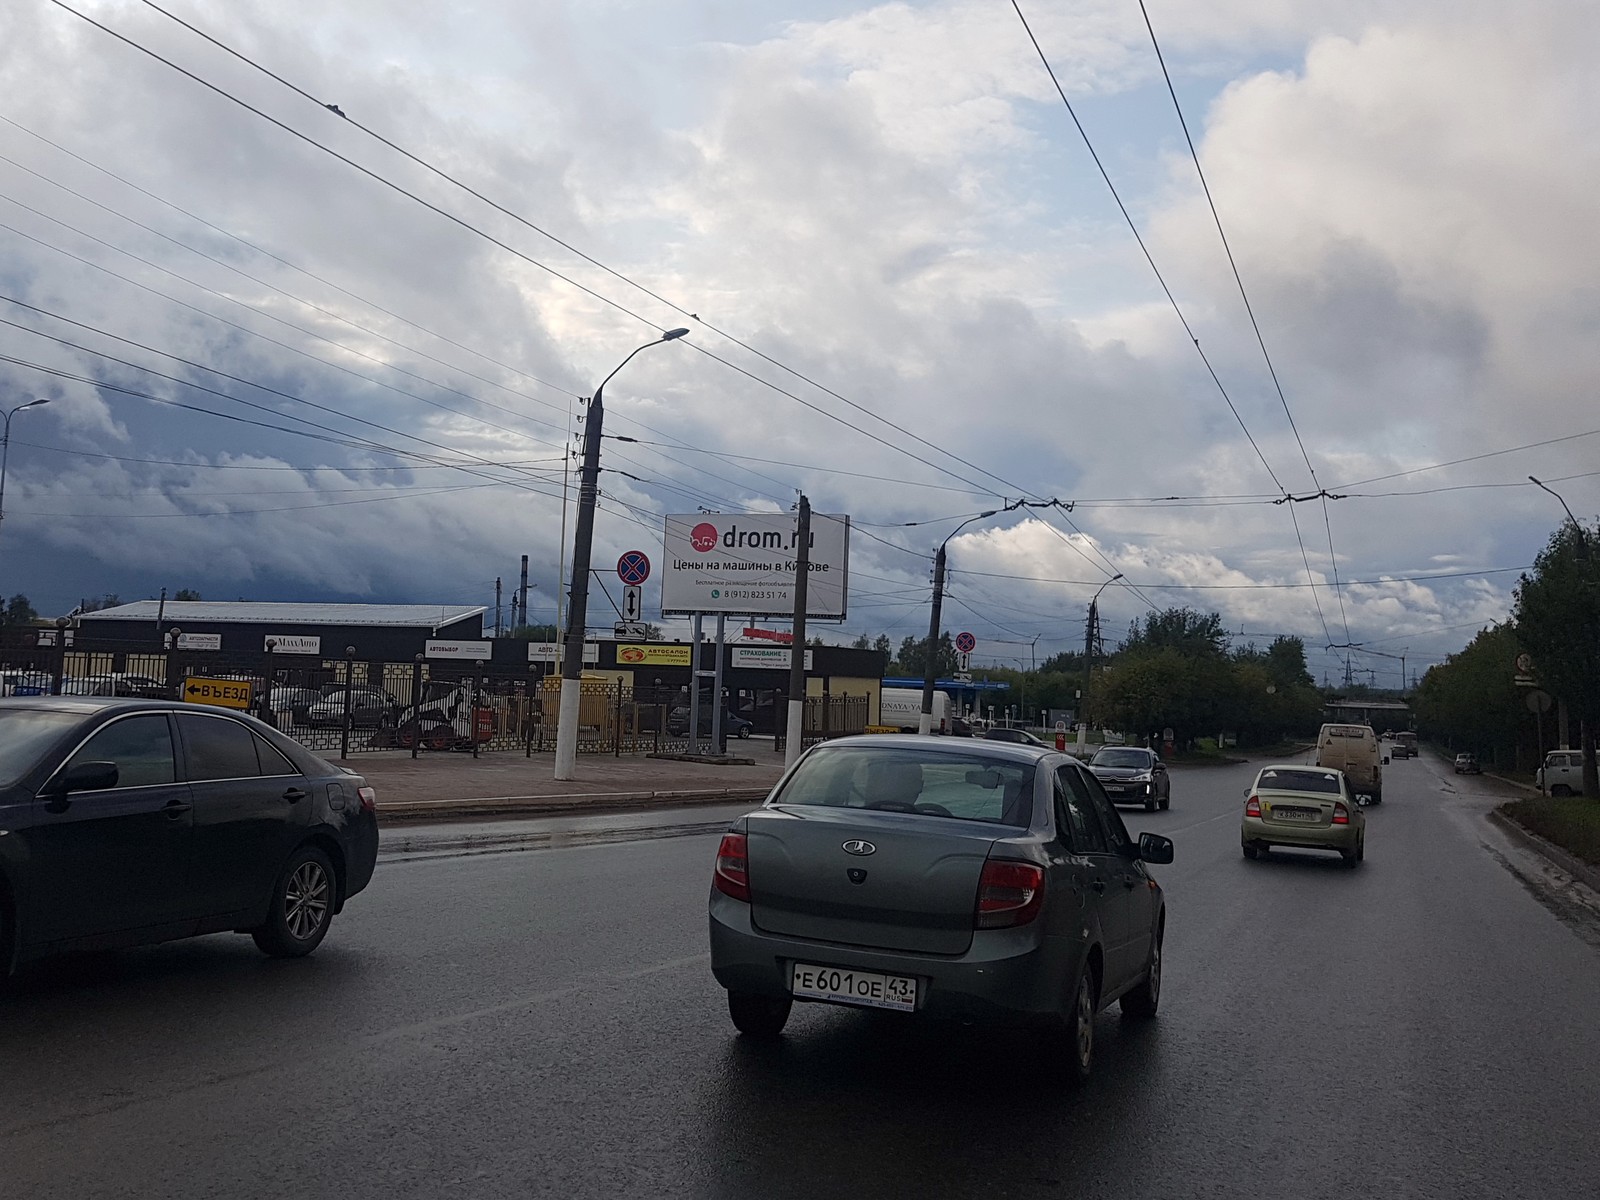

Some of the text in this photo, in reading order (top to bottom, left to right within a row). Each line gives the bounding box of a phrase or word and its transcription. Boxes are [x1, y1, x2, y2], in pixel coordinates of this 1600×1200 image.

[673, 559, 704, 571] Цены
[722, 562, 772, 571] машины
[775, 563, 782, 571] в
[785, 561, 829, 572] Киове
[724, 590, 787, 599] 8 (912) 823 51 74
[739, 649, 782, 657] СТРАХОВАНИЕ
[201, 685, 249, 703] ВЪЕЗД
[802, 969, 909, 998] Е601ОЕ 43
[886, 994, 901, 1002] RUS
